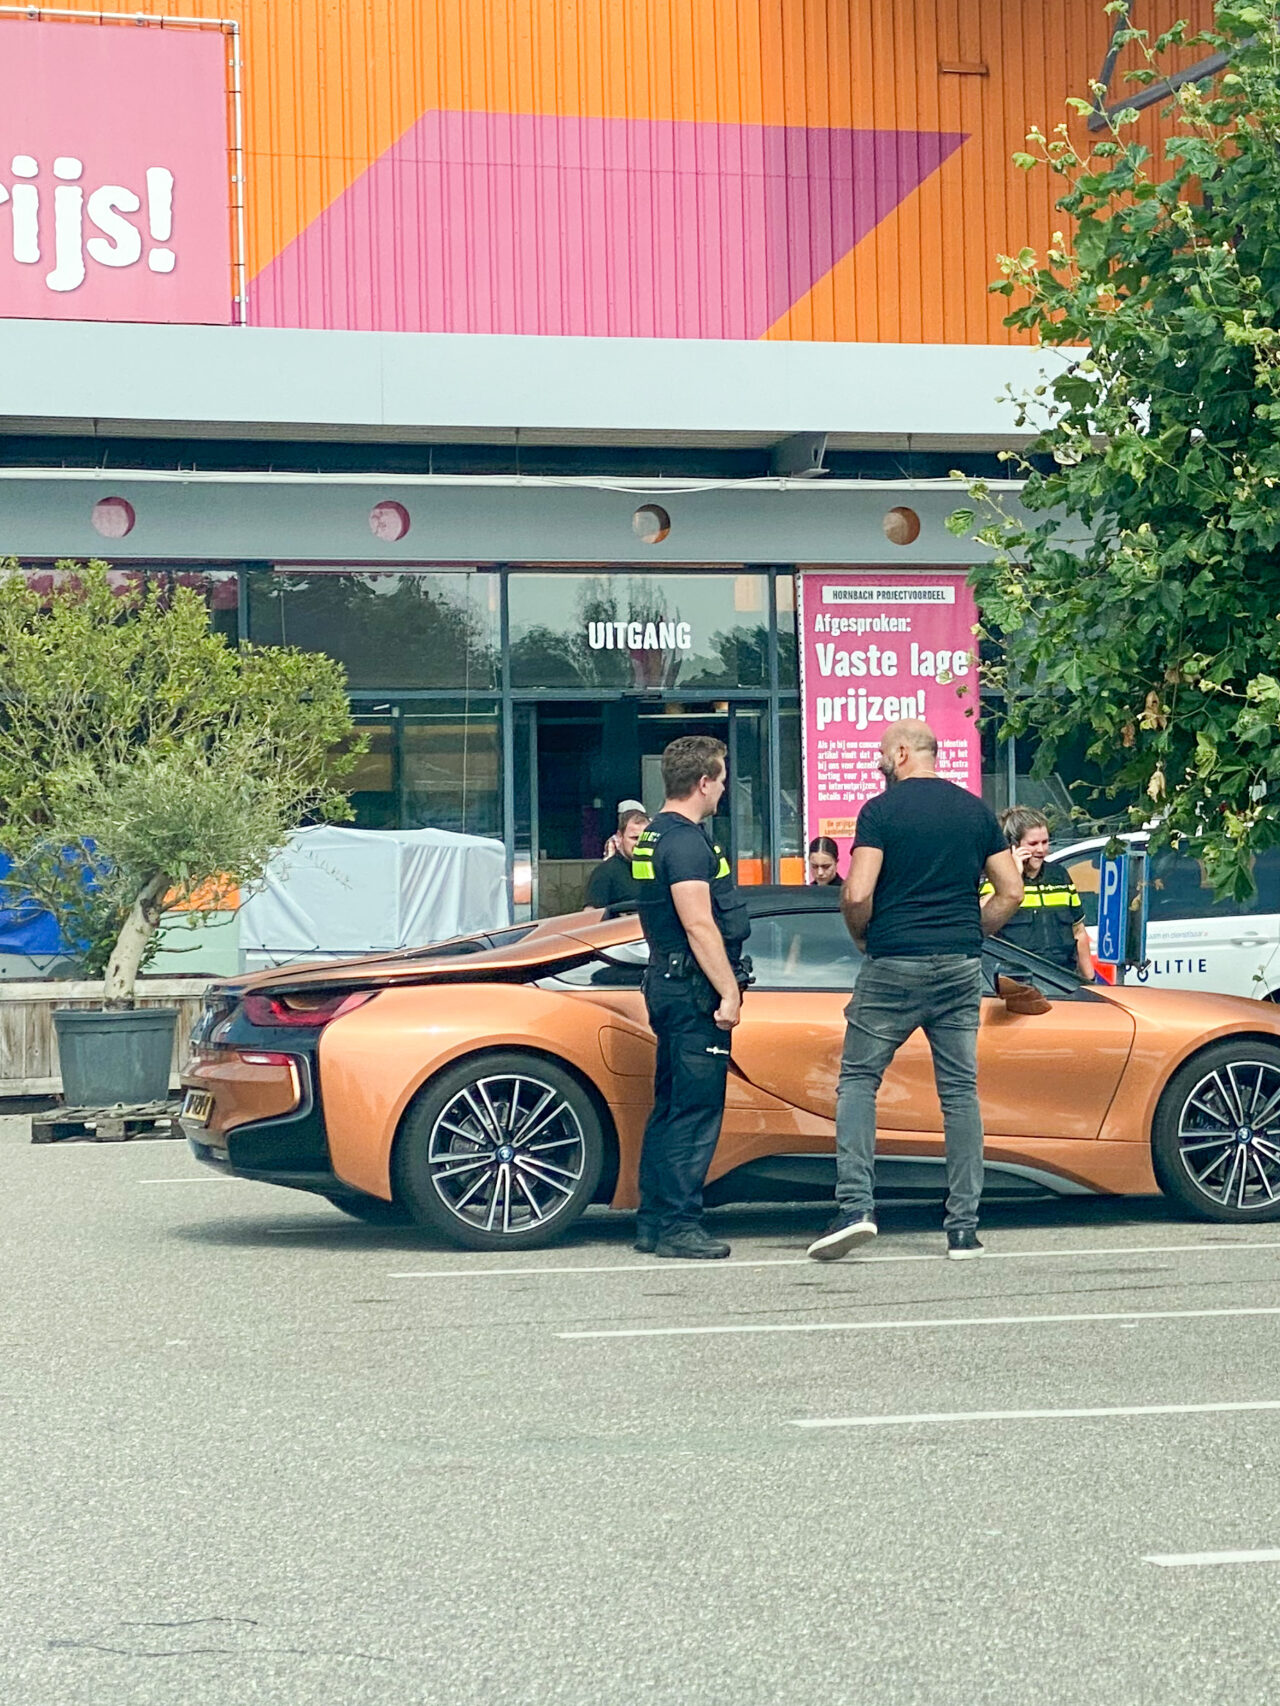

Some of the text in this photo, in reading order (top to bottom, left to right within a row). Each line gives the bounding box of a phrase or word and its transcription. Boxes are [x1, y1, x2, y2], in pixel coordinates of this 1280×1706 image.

[0, 155, 176, 292] ijs!
[832, 590, 946, 600] HORNBACH PROJECTVOORDEEL
[588, 621, 692, 650] UITGANG
[814, 613, 912, 636] Afgesproken:
[815, 642, 969, 685] Vaste lage
[816, 688, 926, 731] prijzen!
[1104, 861, 1118, 915] P
